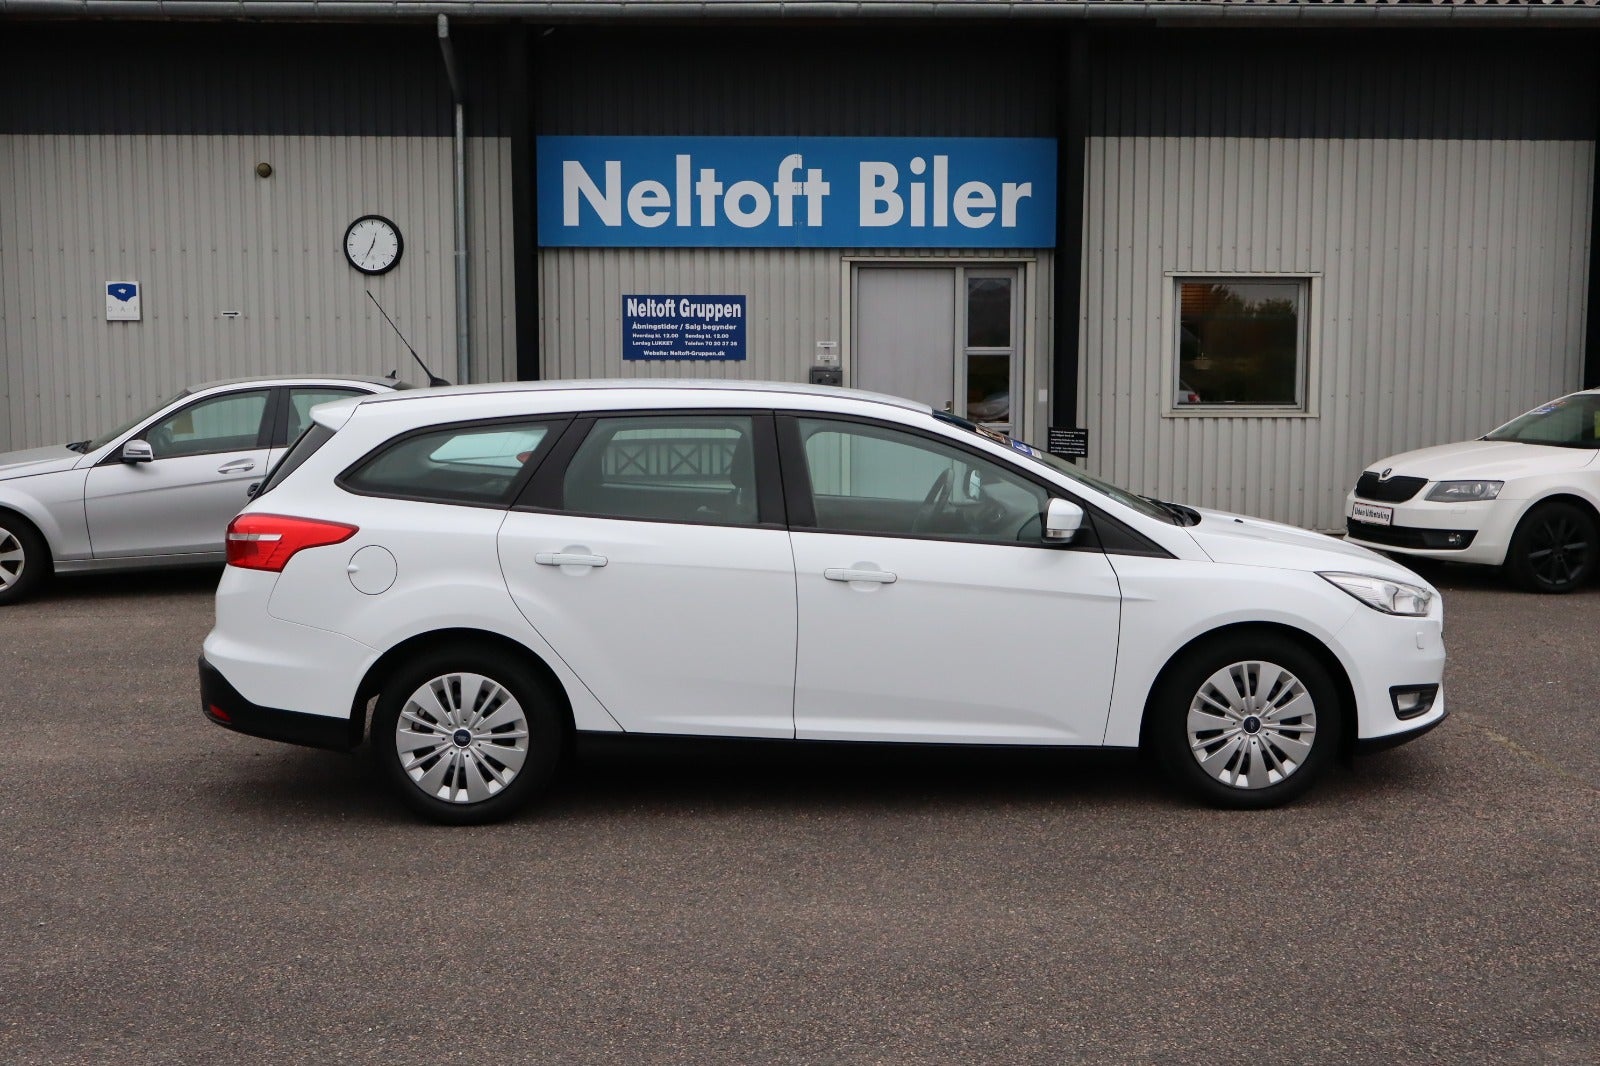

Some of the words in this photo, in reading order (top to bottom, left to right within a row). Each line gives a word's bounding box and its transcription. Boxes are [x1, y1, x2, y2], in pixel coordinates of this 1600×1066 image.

[562, 153, 831, 228] Neltoft
[859, 155, 1033, 228] Biler
[627, 298, 676, 317] Neltoft
[679, 298, 741, 321] Gruppen
[632, 322, 678, 331] Åbningstider
[685, 323, 701, 331] Salg
[702, 323, 737, 331] begynder
